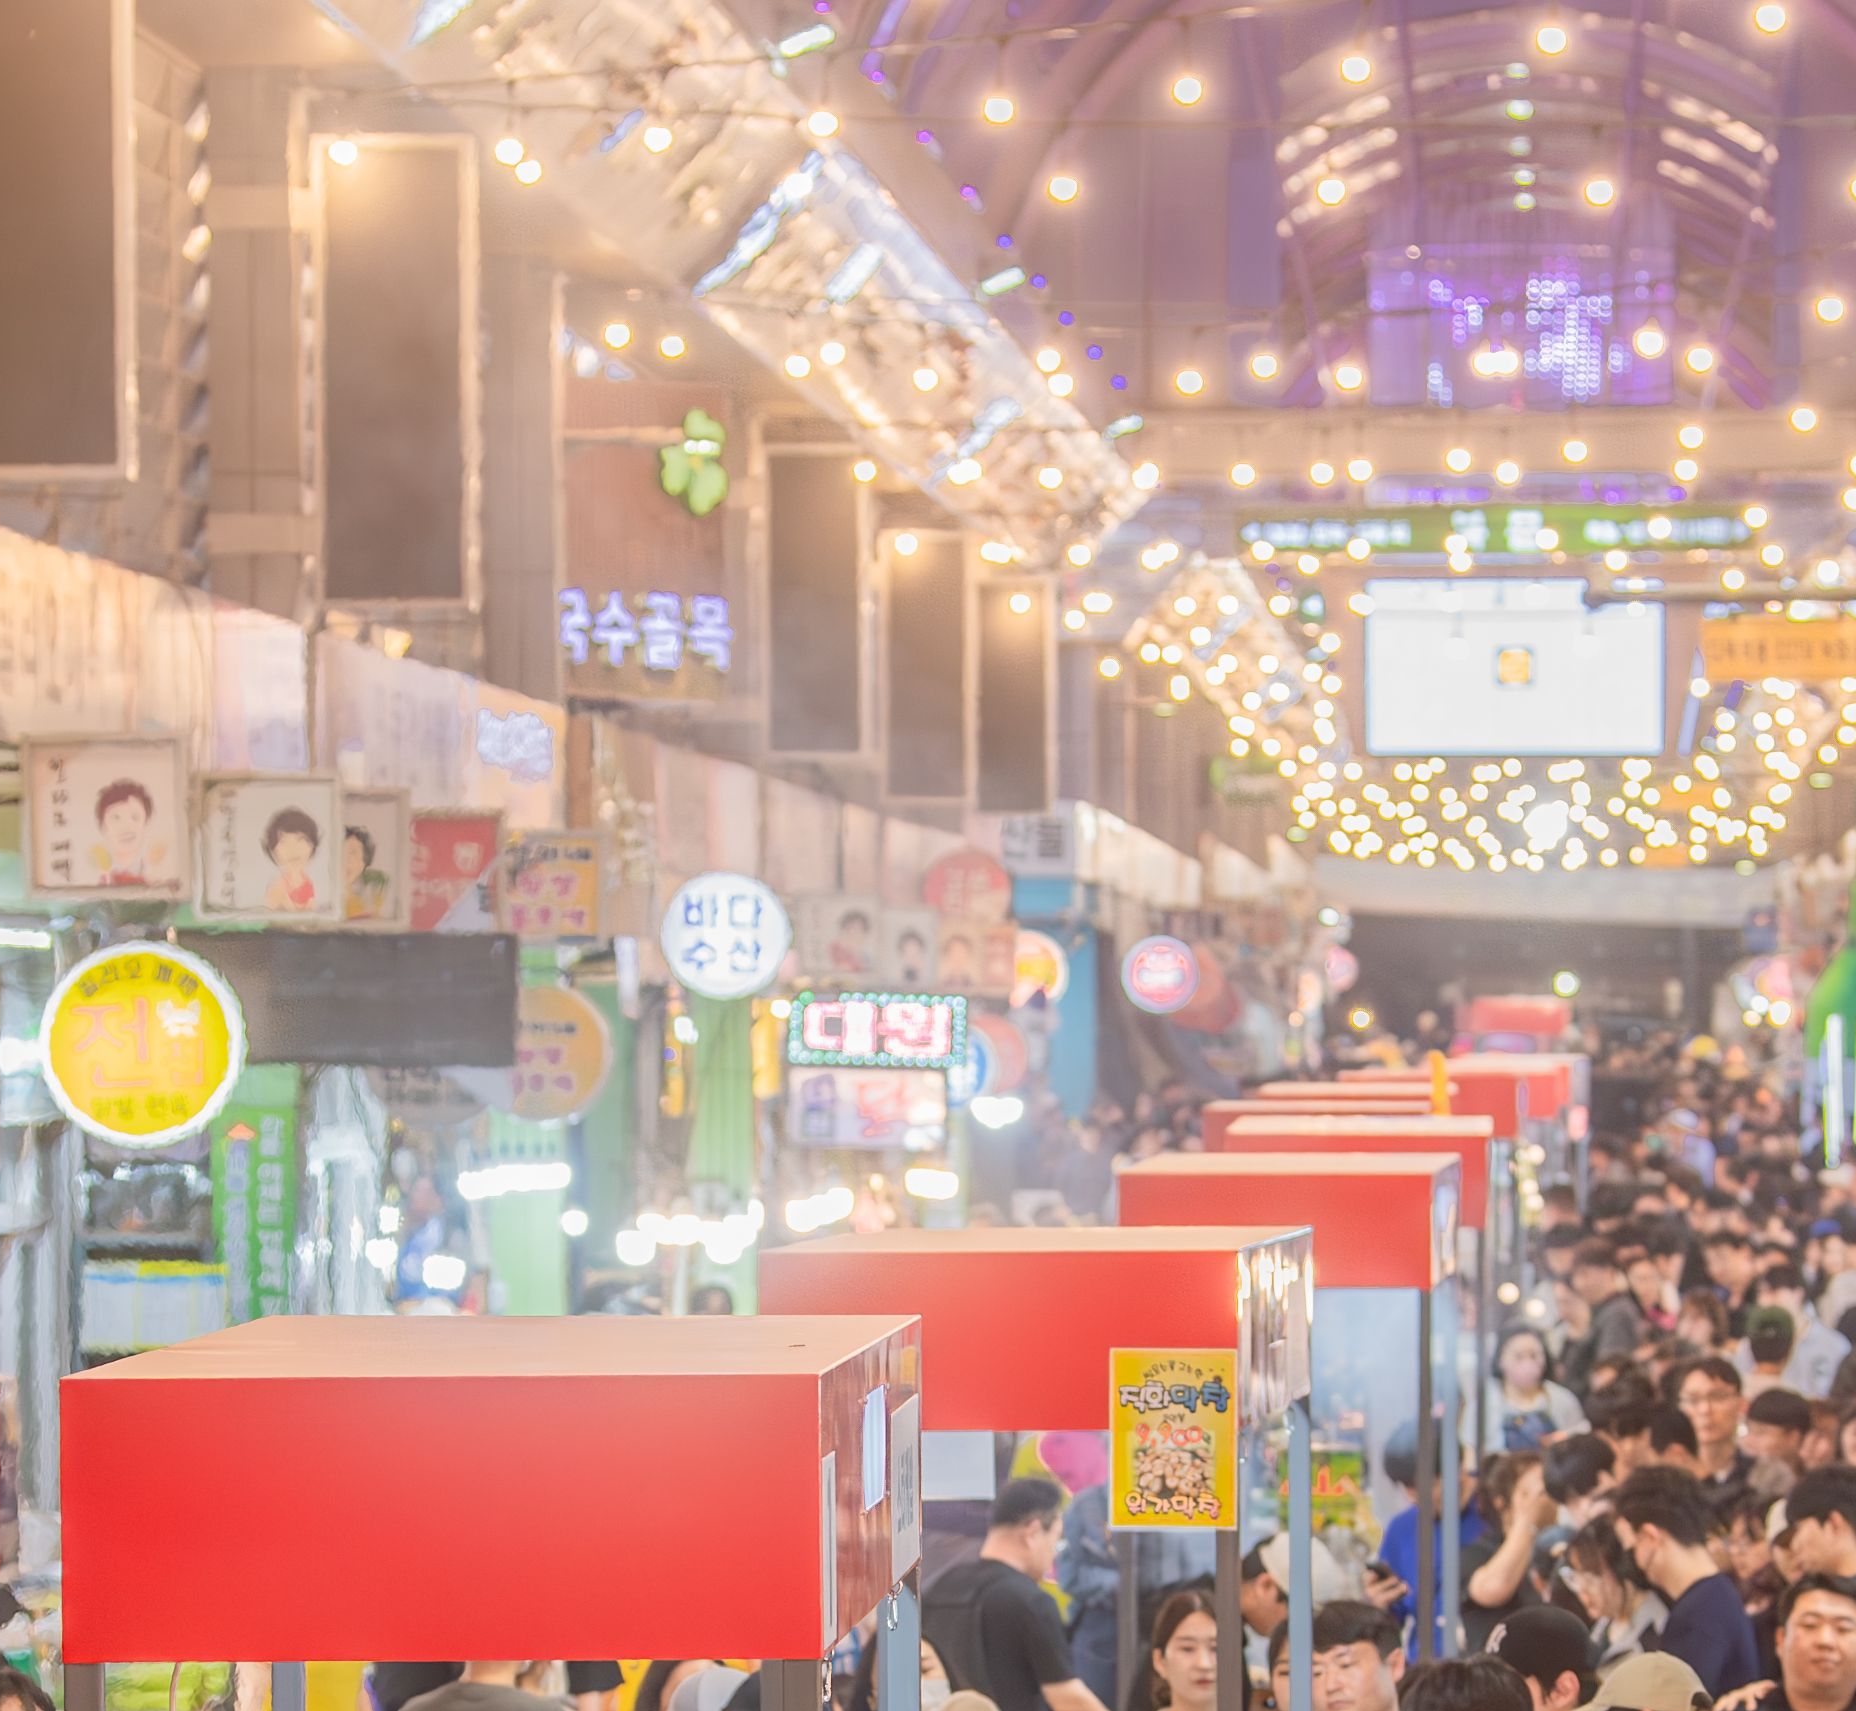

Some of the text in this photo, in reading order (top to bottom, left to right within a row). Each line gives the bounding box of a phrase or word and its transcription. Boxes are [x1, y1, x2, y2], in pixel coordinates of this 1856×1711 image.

[558, 587, 735, 671] 국수골목
[683, 894, 763, 928] 바다
[682, 939, 763, 972] 수산
